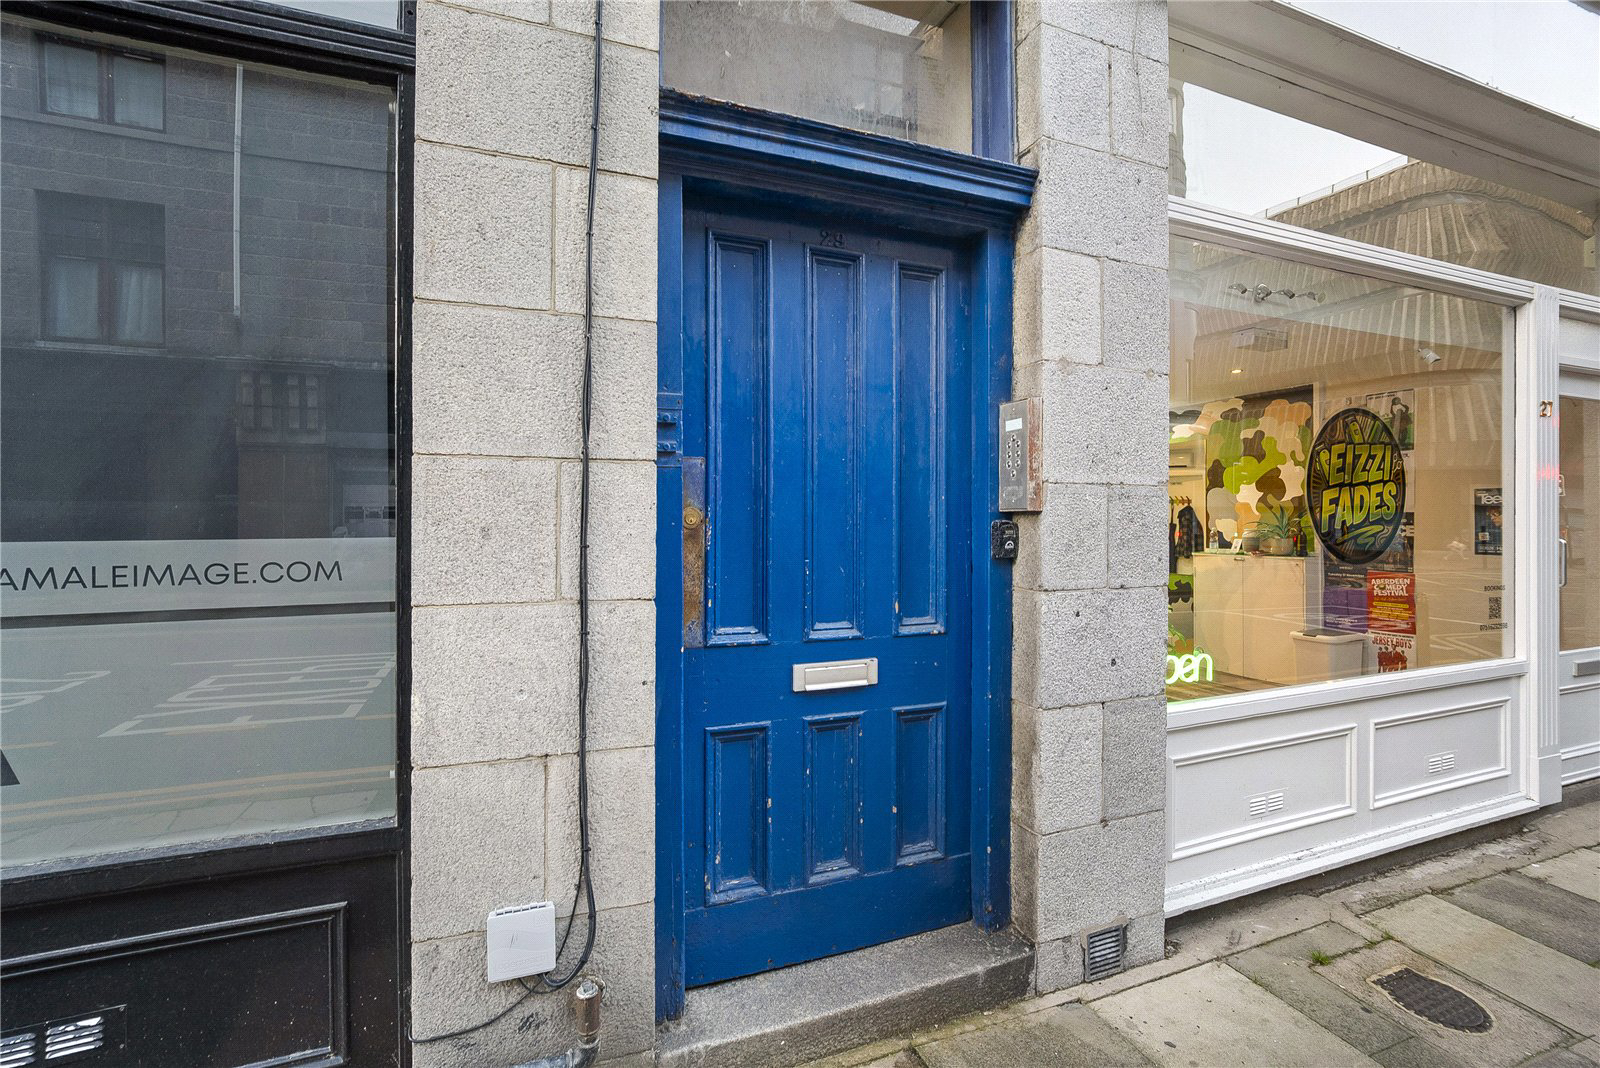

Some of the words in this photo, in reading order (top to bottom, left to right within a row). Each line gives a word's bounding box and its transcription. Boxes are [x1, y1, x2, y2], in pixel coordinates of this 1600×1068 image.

[1539, 400, 1553, 417] 27
[1321, 481, 1397, 533] FADES
[1371, 634, 1395, 647] JERSEY
[1395, 637, 1413, 650] BOYS
